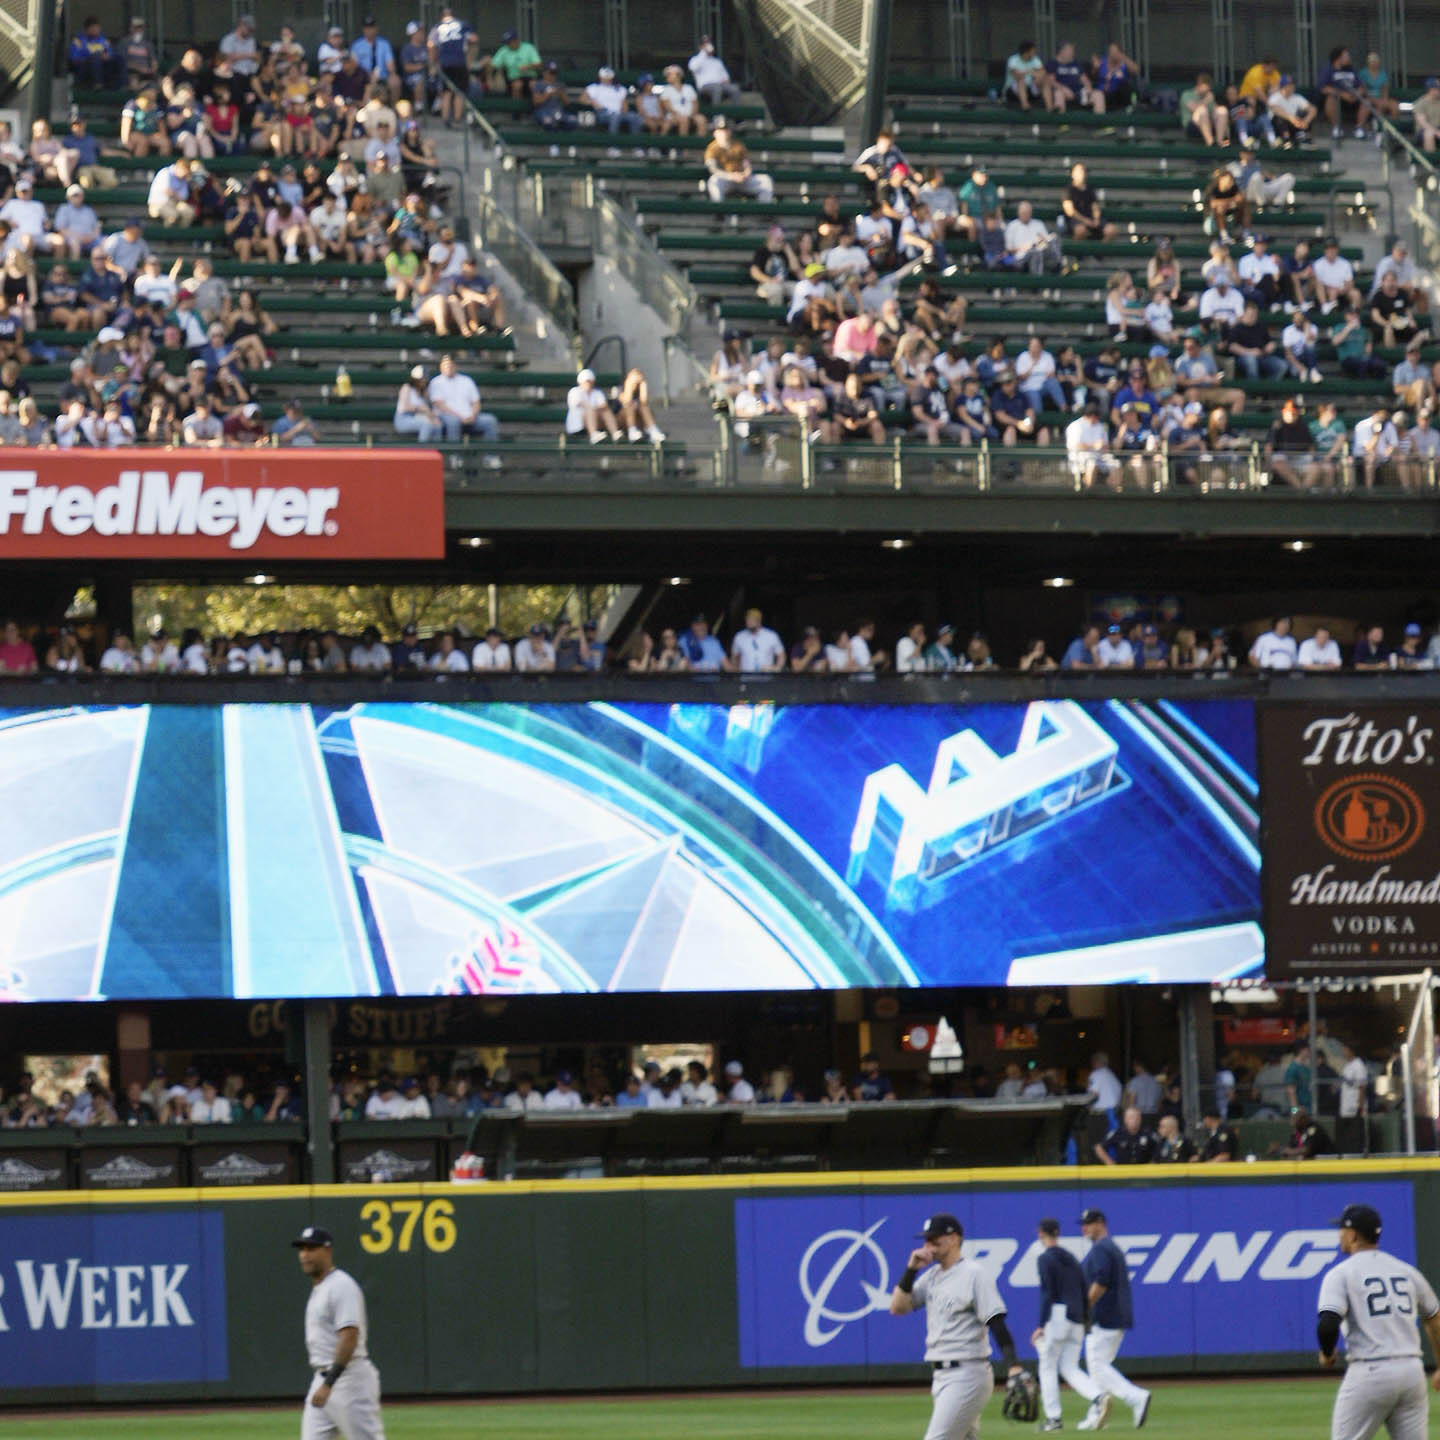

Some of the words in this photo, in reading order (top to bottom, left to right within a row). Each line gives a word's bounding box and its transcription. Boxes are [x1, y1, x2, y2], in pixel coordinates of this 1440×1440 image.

[1302, 712, 1434, 766] Tito's
[1332, 915, 1416, 935] VODKA
[358, 1198, 458, 1255] 376
[15, 1258, 196, 1331] WEEK
[1363, 1276, 1413, 1317] 25
